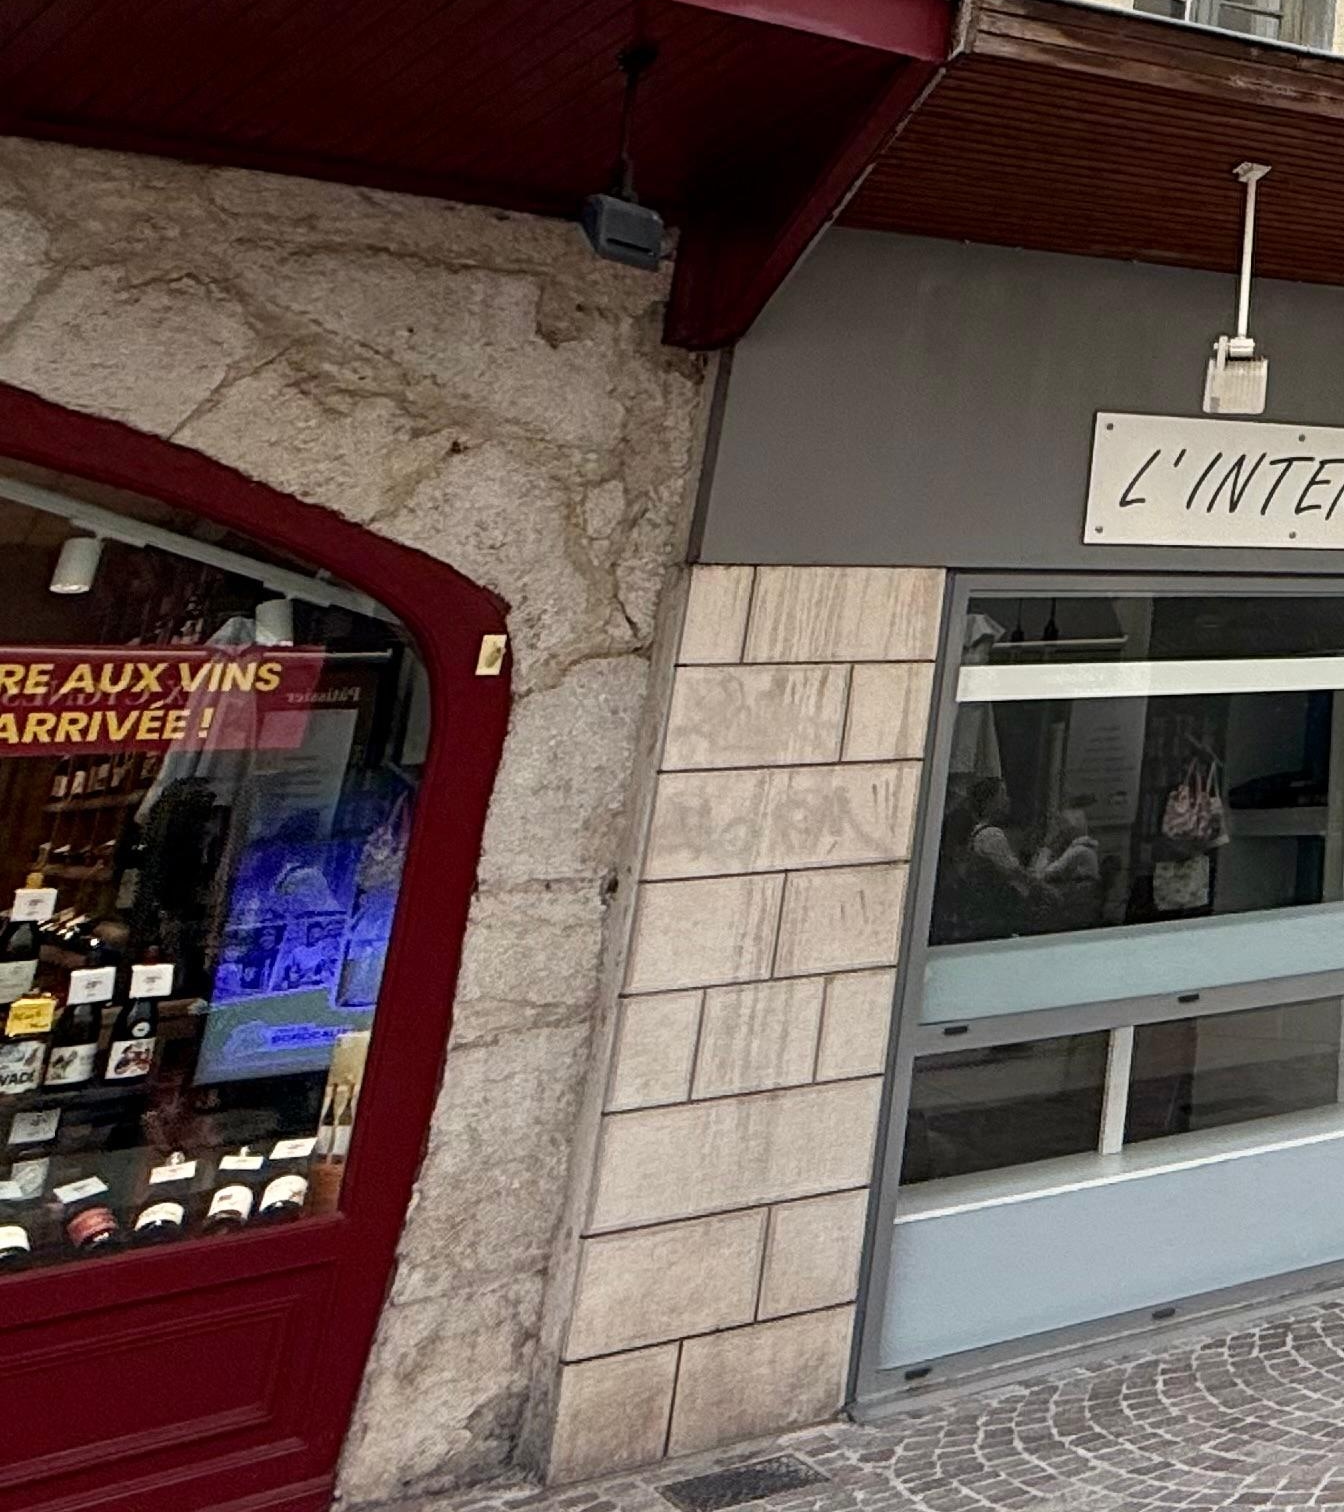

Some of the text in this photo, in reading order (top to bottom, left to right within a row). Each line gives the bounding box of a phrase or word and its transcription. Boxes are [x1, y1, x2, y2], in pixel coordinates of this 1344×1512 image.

[59, 662, 171, 695] AUX
[181, 661, 283, 694] VINS
[0, 700, 191, 744] ARRIVÉE
